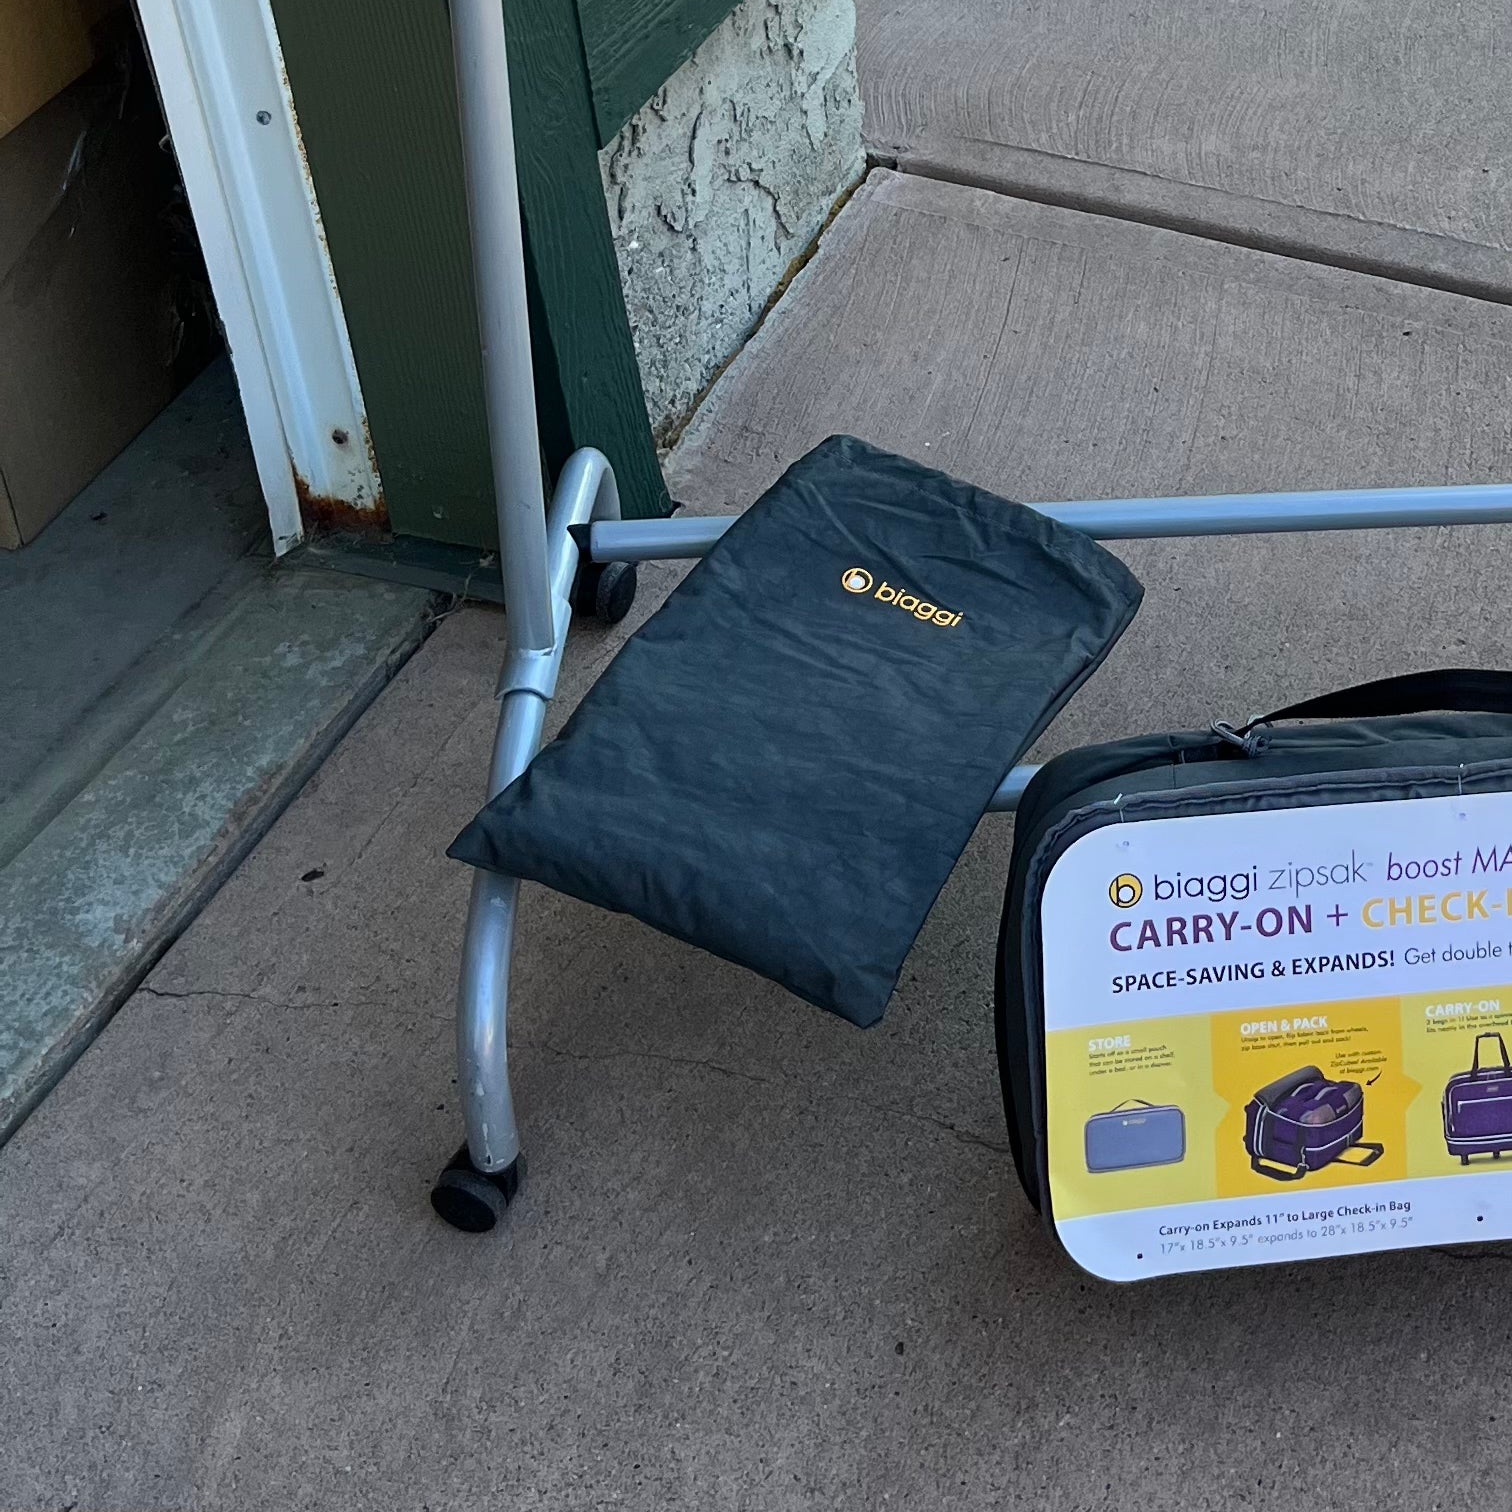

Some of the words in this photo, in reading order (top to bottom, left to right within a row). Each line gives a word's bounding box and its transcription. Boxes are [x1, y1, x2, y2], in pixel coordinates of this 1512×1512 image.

[874, 581, 964, 627] biaggi
[1154, 865, 1258, 903] biaggi
[1386, 850, 1463, 882] boost
[1109, 904, 1312, 952] CARRY-ON
[1327, 904, 1348, 927] +
[1112, 961, 1265, 994] SPACE-SAVING
[1271, 960, 1286, 977] &
[1292, 950, 1395, 976] EXPANDS!
[1404, 947, 1436, 966] Get
[1442, 941, 1502, 963] double
[1240, 1020, 1277, 1035] OPEN
[1280, 1019, 1290, 1032] &
[1293, 1015, 1328, 1029] PACK
[1425, 1000, 1500, 1017] CARRY-ON
[1088, 1035, 1132, 1051] STORE
[1159, 1222, 1210, 1236] Carry-on
[1213, 1215, 1262, 1231] Expands
[1287, 1212, 1299, 1223] to
[1302, 1210, 1335, 1222] Large
[1337, 1202, 1387, 1217] Check-in
[1389, 1200, 1411, 1213] Bag
[1258, 1229, 1304, 1244] expands
[1306, 1229, 1318, 1238] to
